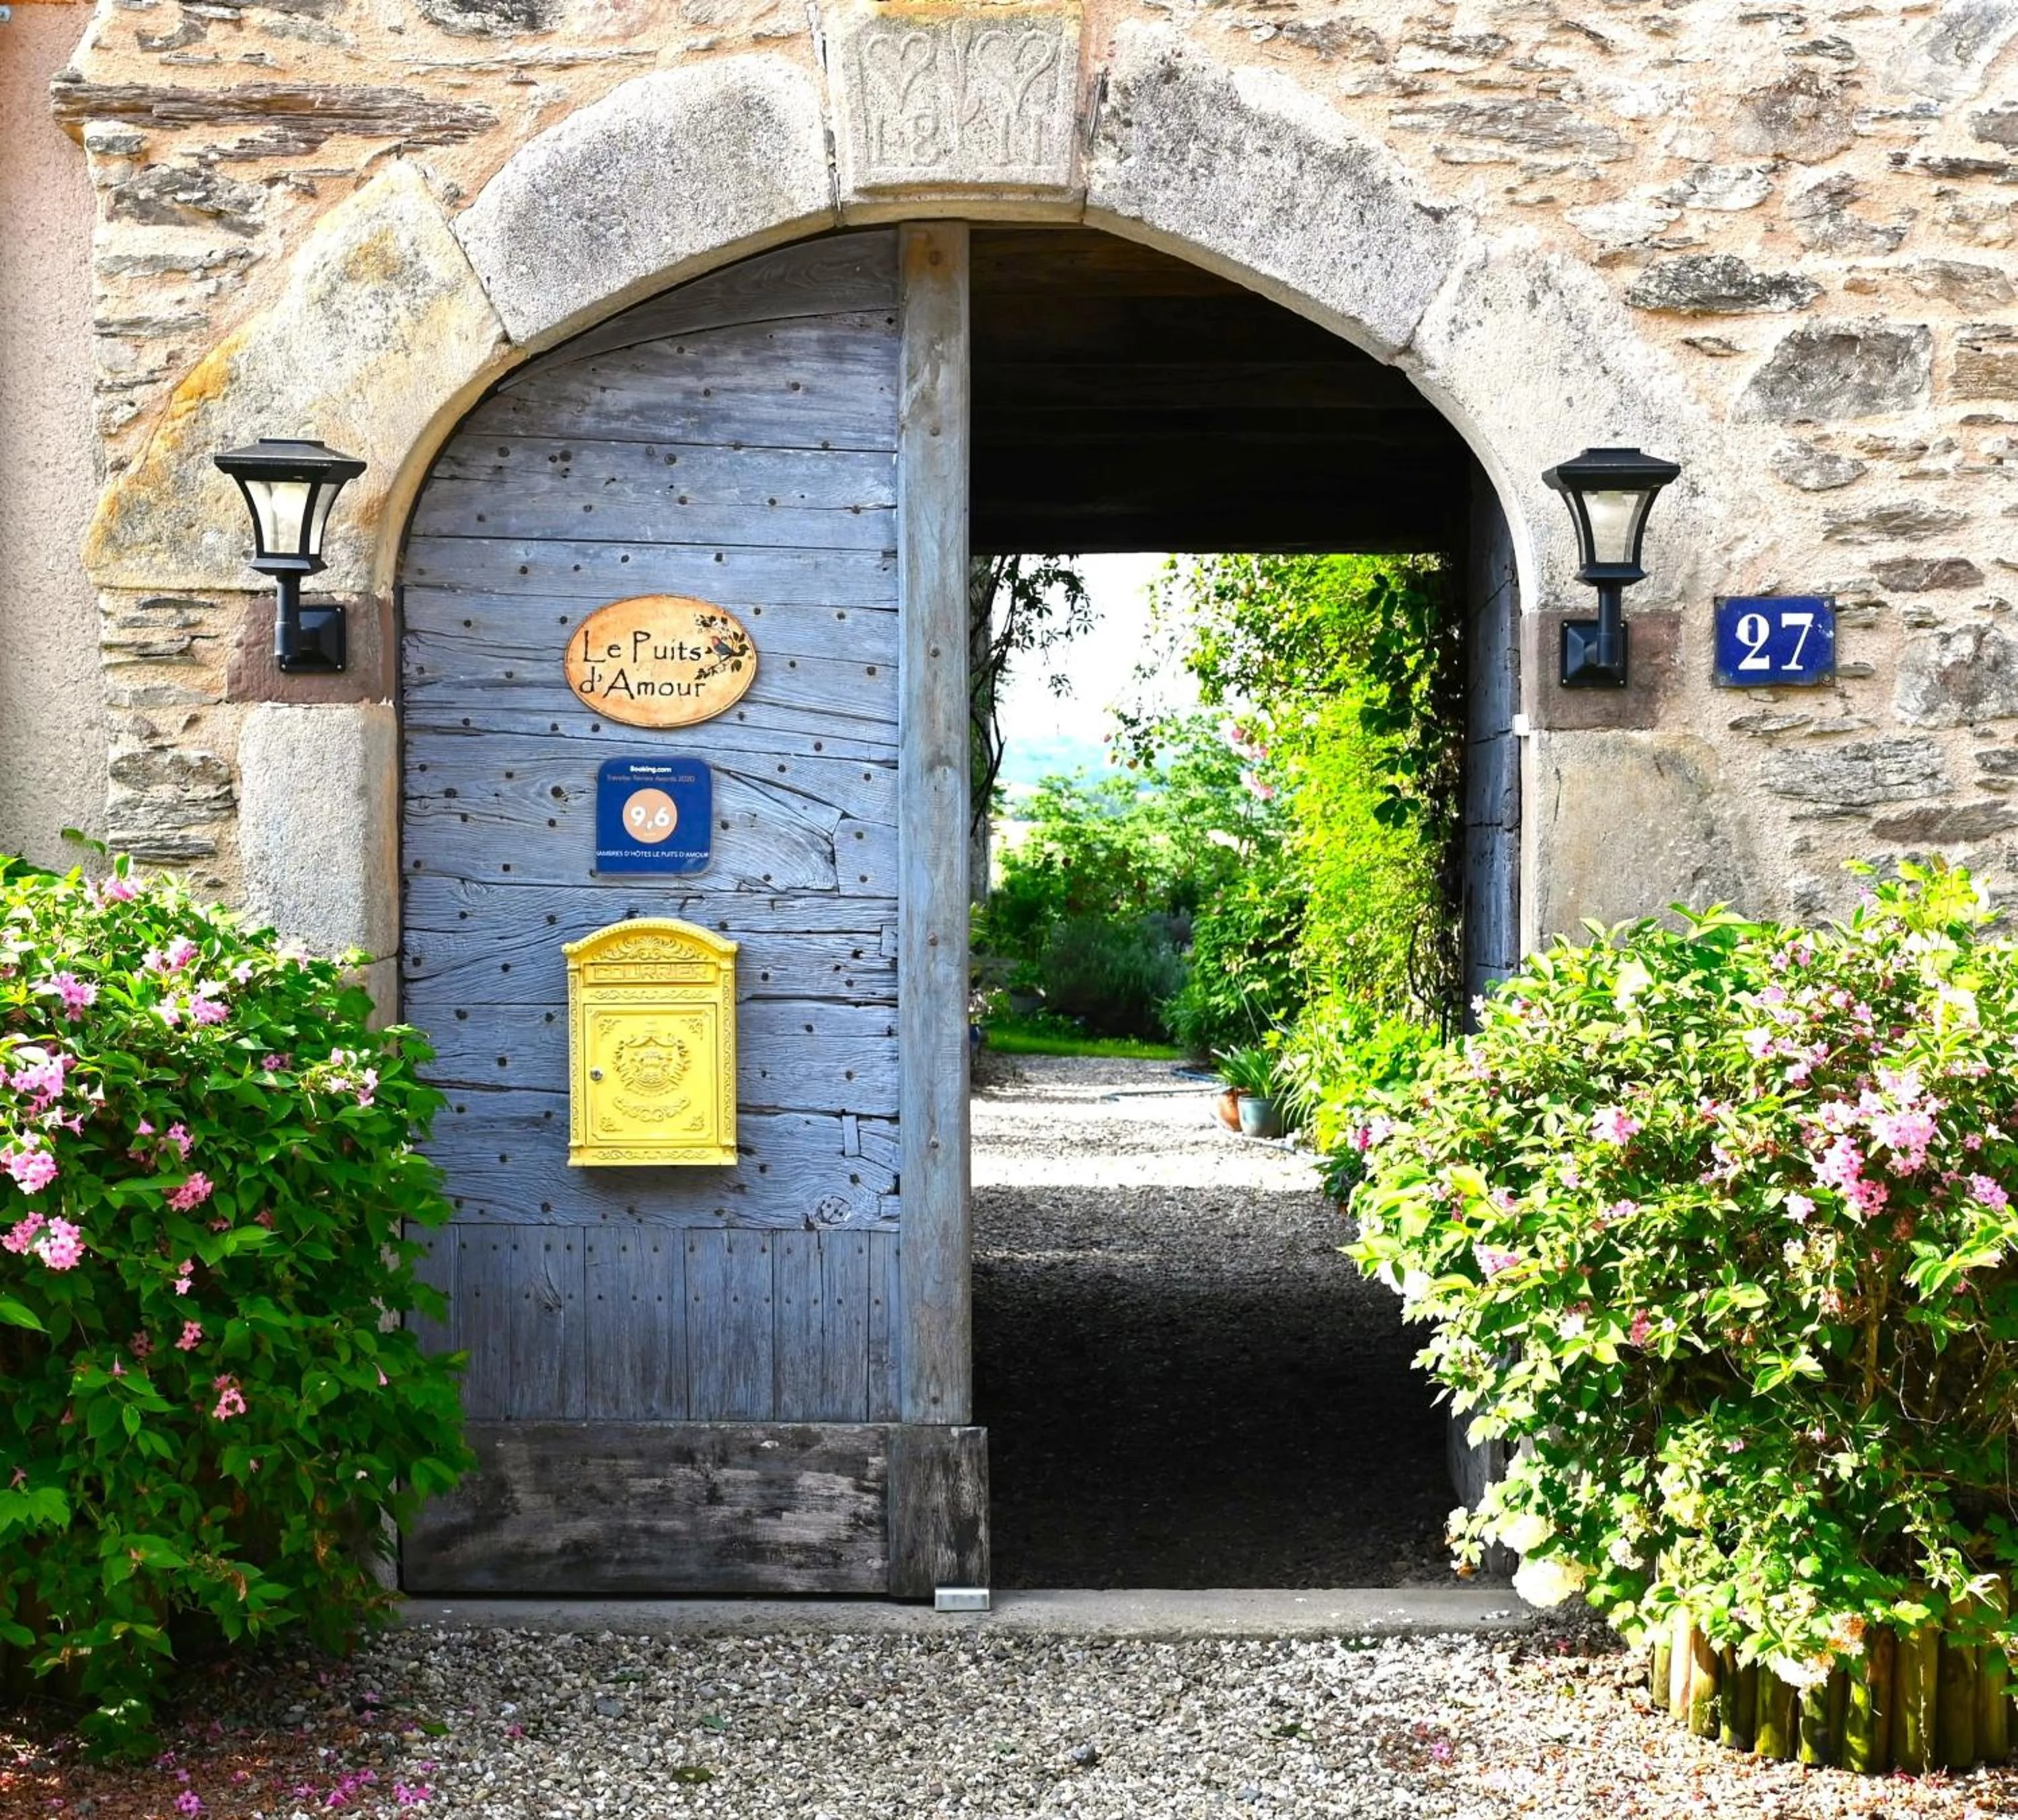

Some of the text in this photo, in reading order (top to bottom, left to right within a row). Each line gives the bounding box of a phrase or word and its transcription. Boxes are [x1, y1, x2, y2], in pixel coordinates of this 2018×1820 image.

[583, 630, 702, 663] Le Puits
[1736, 613, 1814, 671] 27
[578, 666, 706, 699] d'Amour
[630, 765, 672, 774] Booking.com
